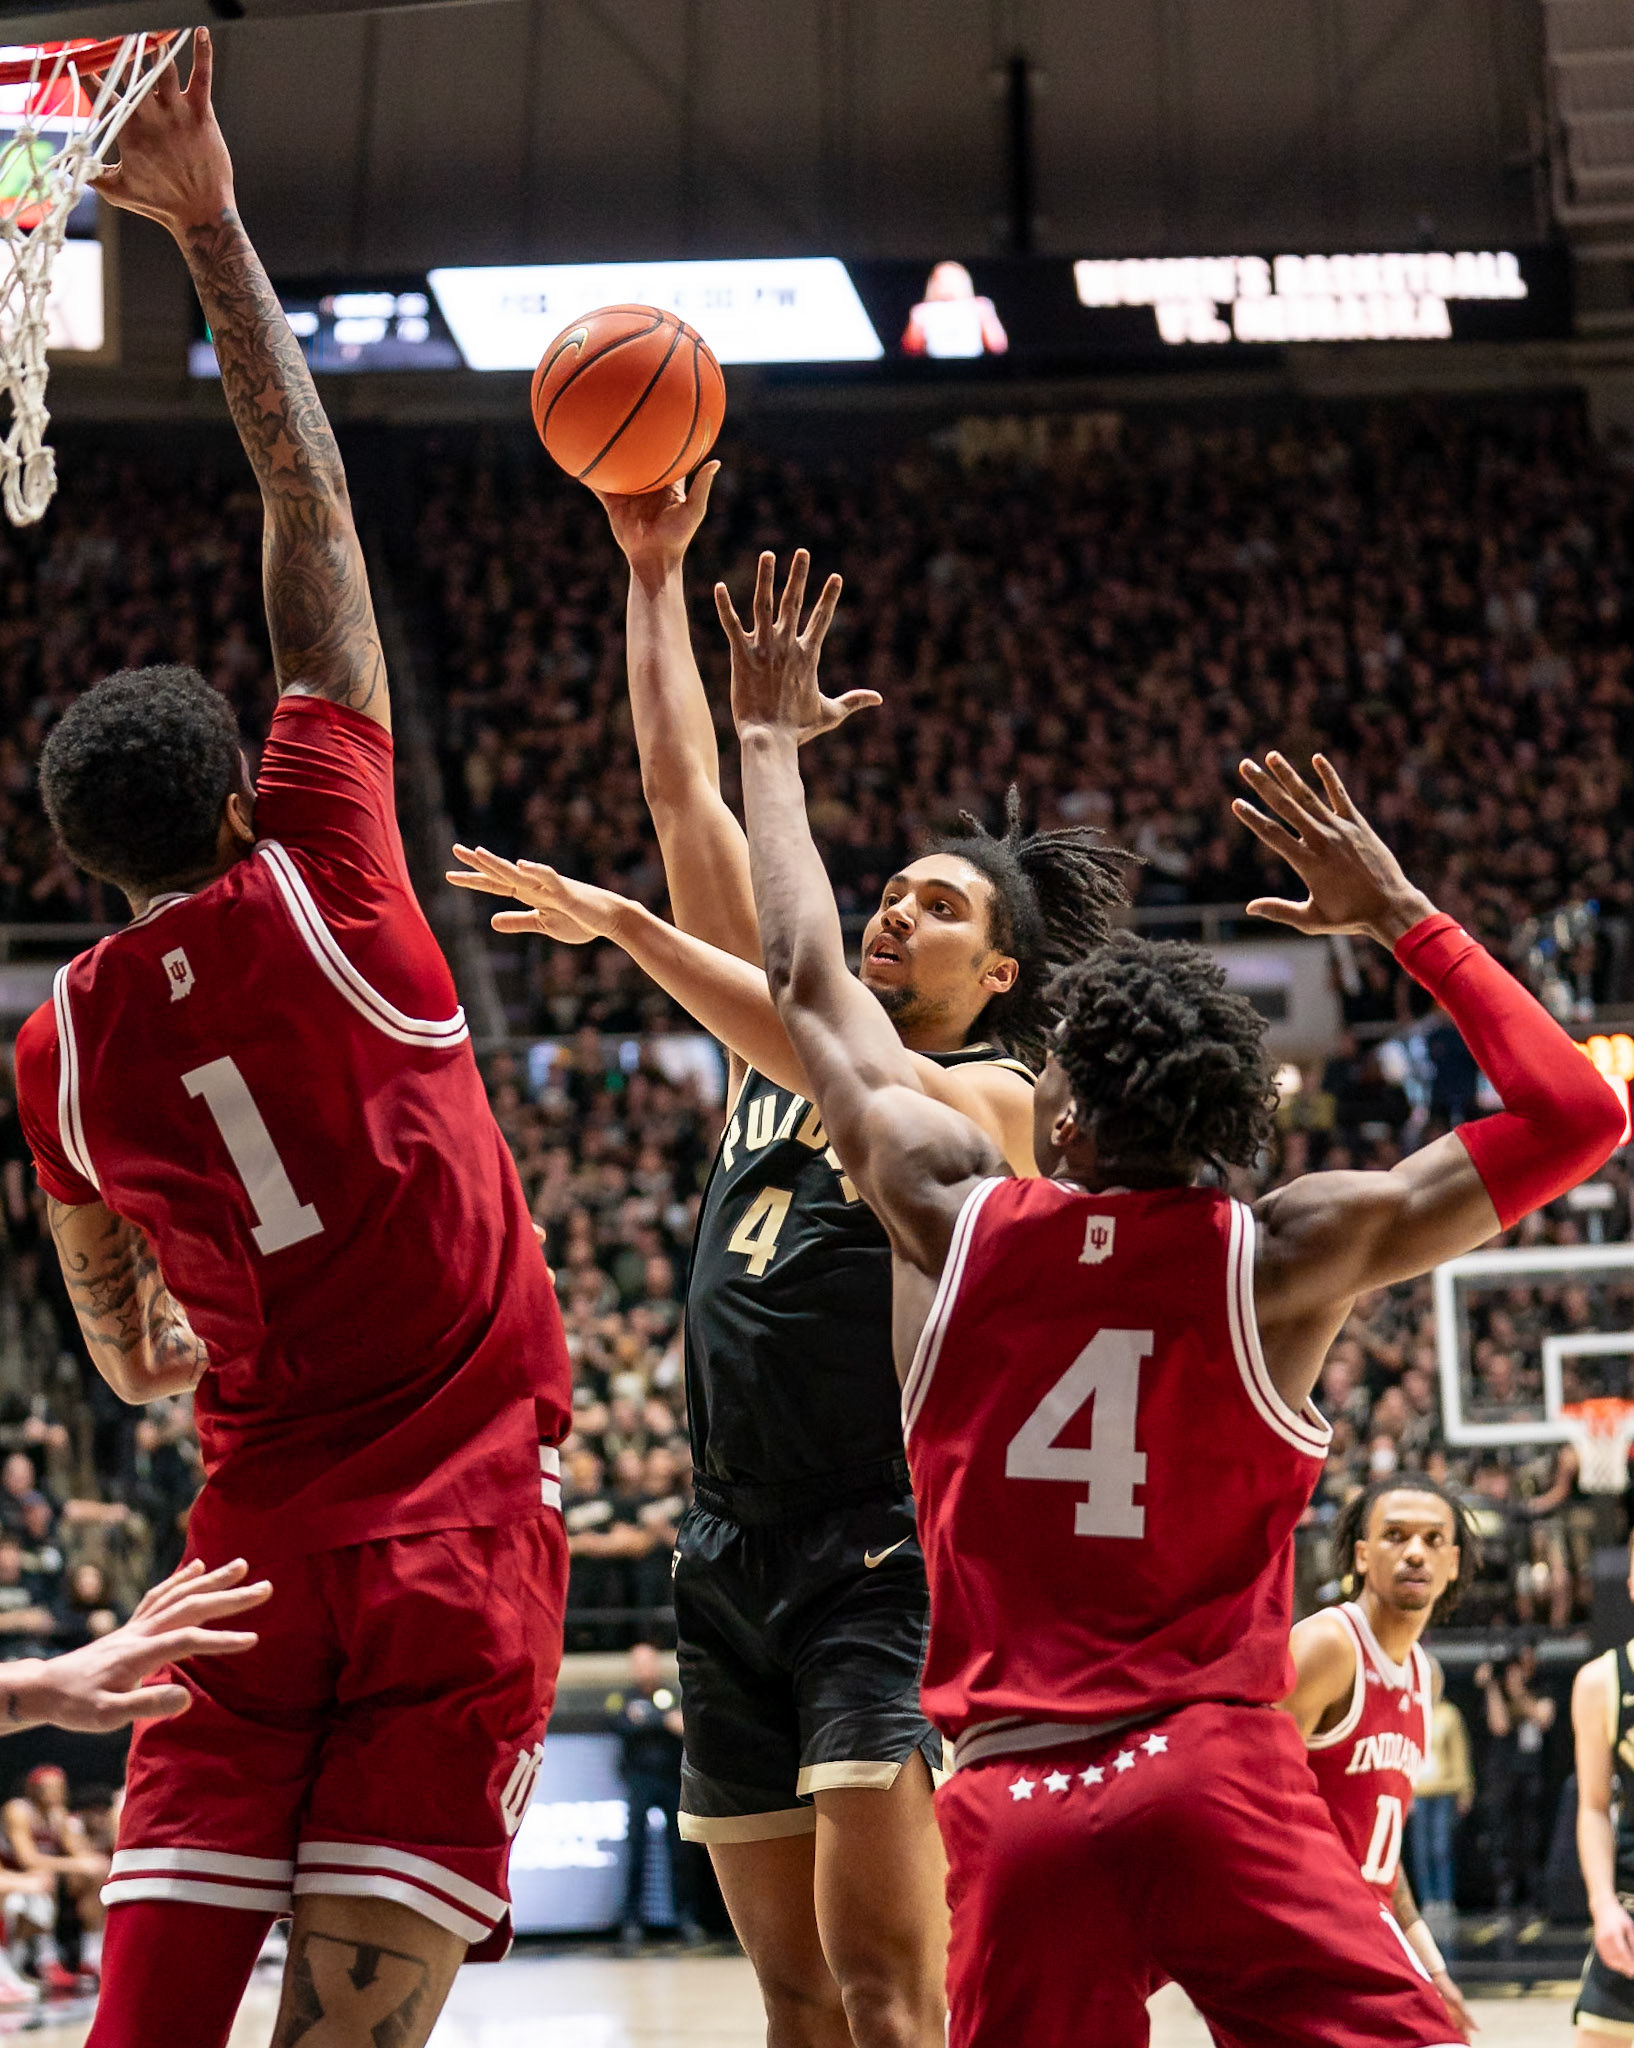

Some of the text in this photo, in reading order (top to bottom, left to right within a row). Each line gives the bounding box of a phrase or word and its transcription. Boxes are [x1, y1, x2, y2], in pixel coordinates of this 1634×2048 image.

[180, 1056, 325, 1256] 1
[727, 1185, 794, 1276] 4
[1005, 1328, 1155, 1539] 4
